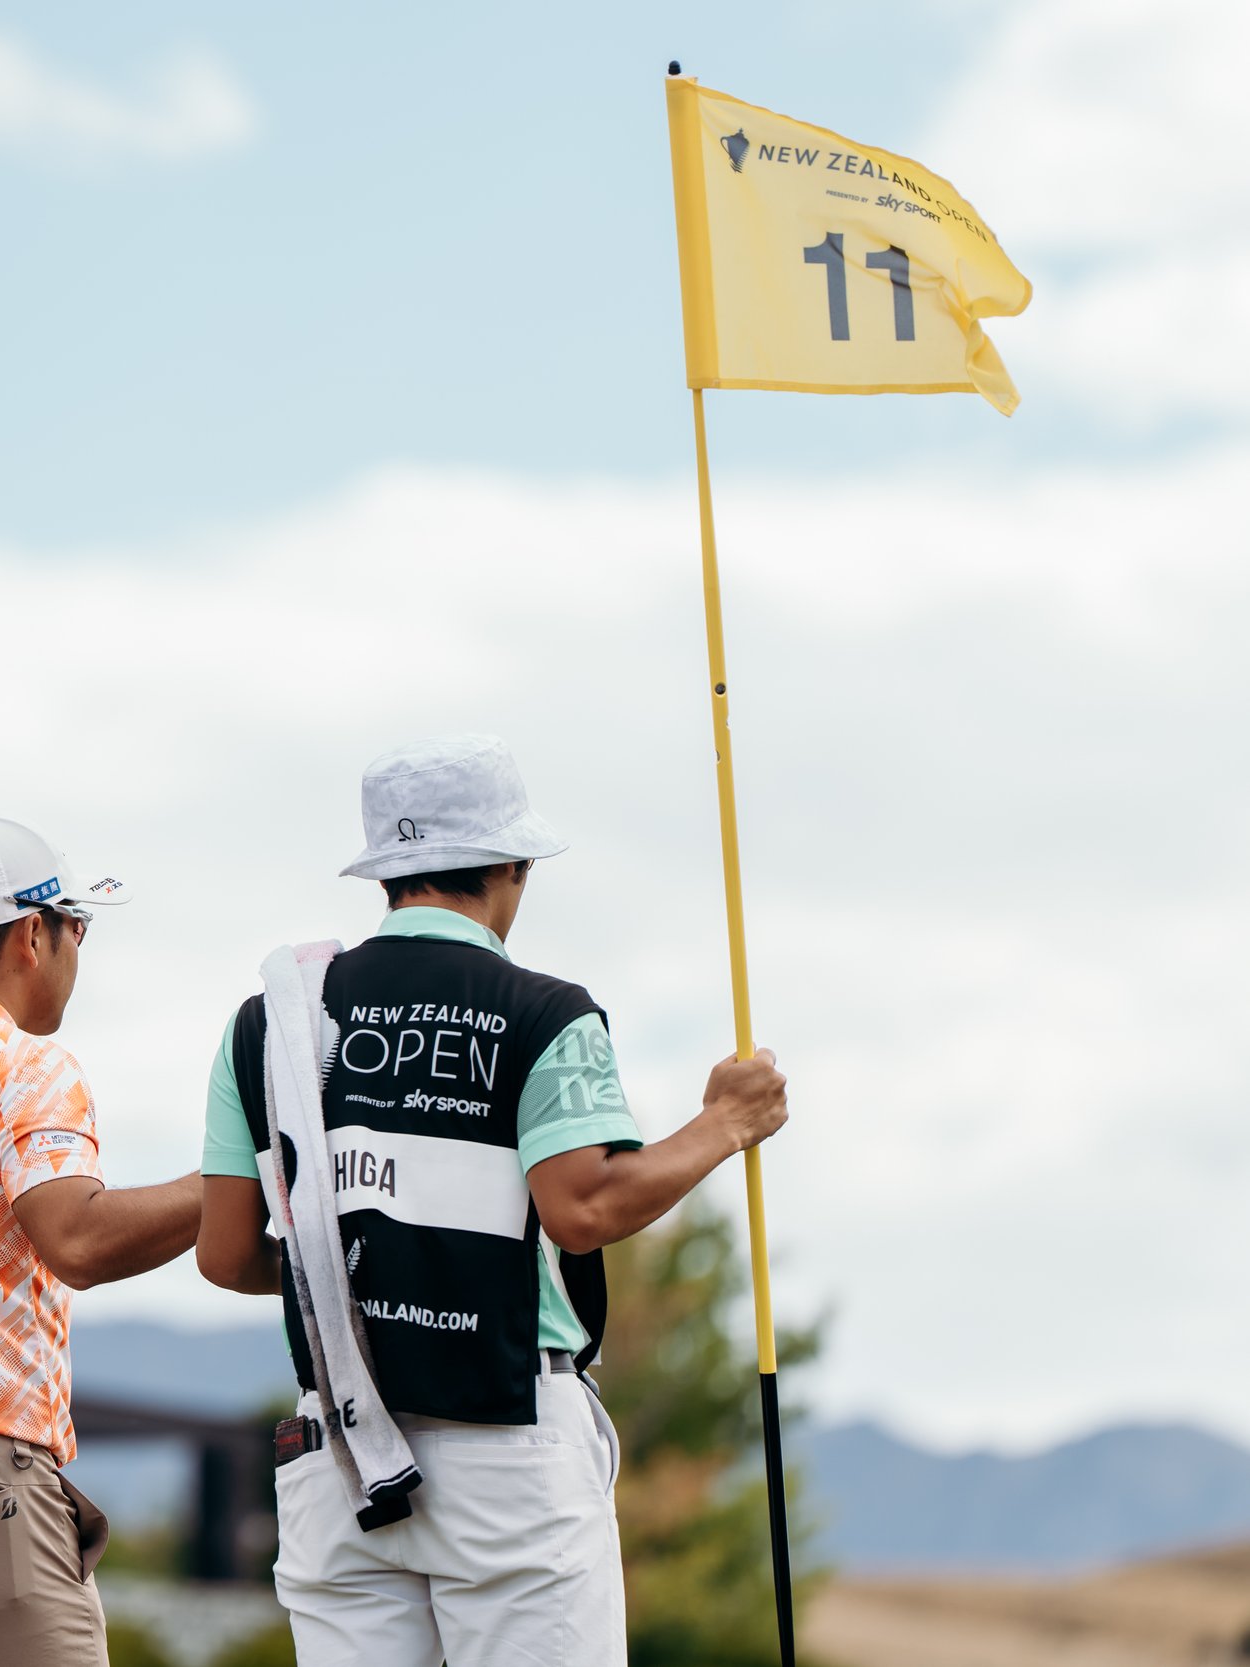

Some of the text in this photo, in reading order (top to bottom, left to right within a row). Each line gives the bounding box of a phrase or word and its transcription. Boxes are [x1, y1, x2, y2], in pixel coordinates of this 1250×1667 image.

[758, 144, 988, 242] NEW ZEALAND OPEN
[803, 231, 915, 341] 11
[350, 1003, 507, 1034] NEW ZEALAND
[341, 1029, 499, 1091] OPEN
[345, 1094, 396, 1108] PRESENTED BY
[334, 1149, 396, 1198] HIGA
